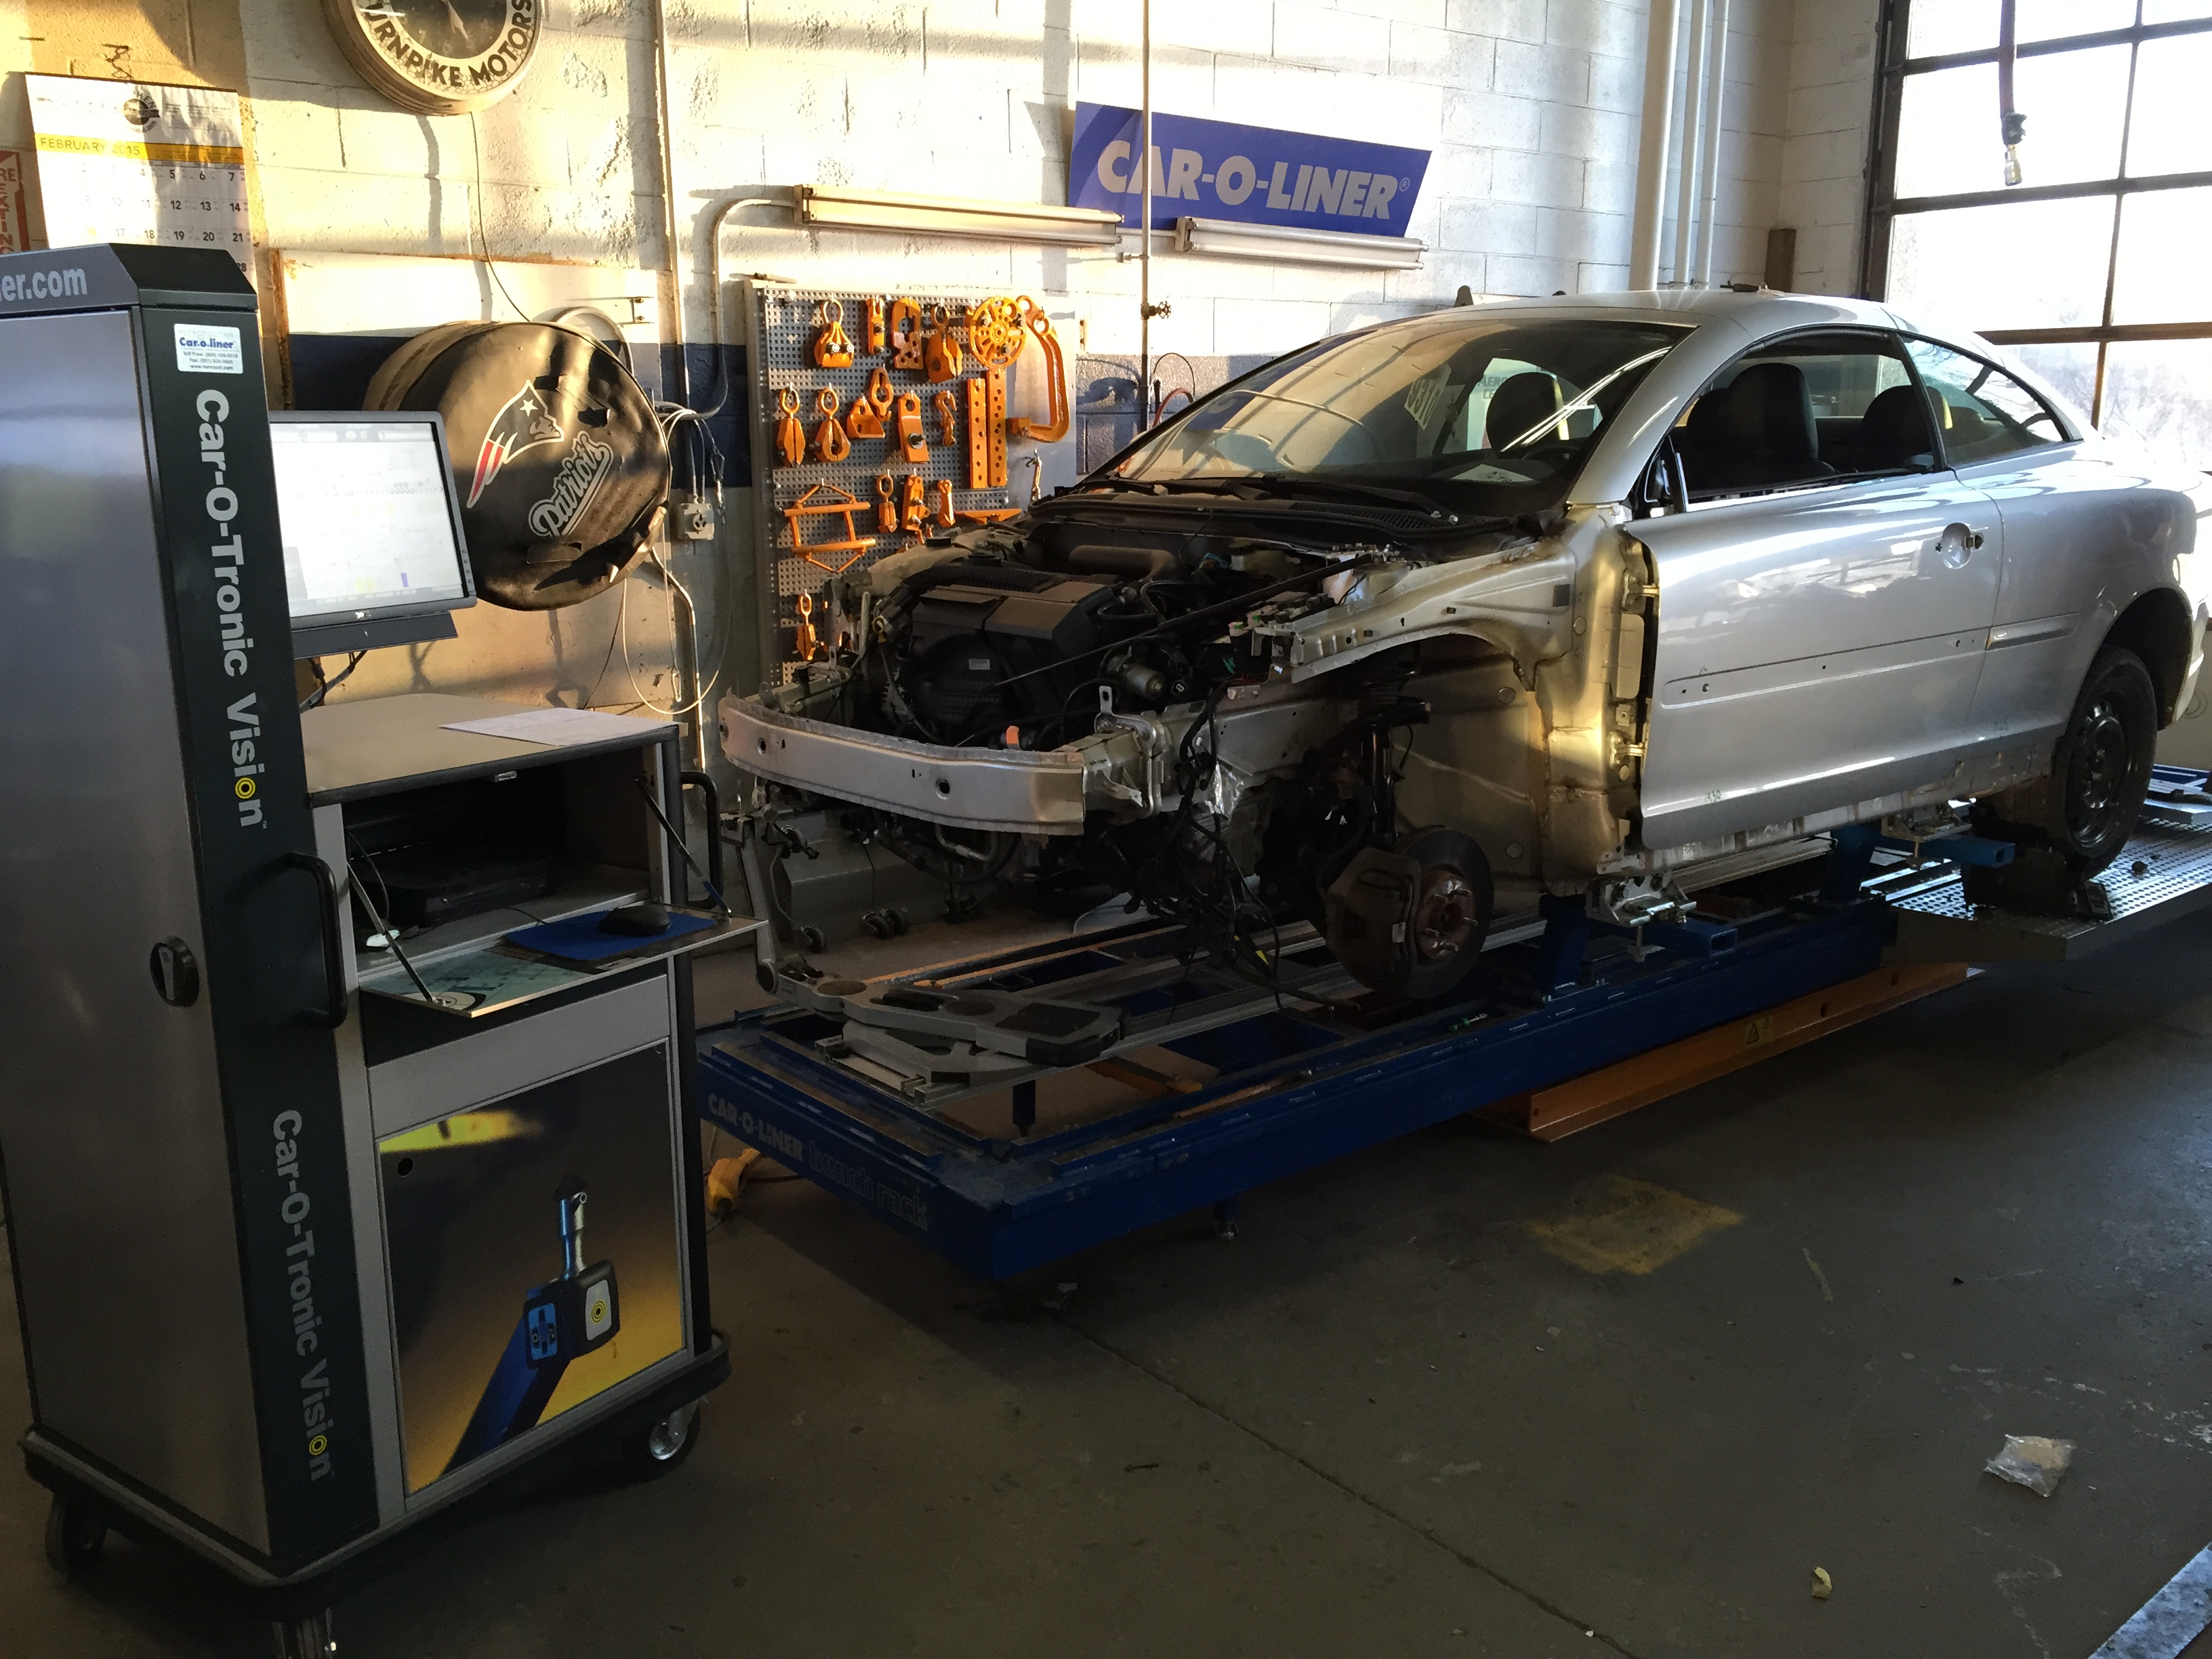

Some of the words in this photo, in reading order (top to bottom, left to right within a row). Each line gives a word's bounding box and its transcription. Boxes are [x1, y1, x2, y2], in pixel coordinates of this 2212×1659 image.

[363, 3, 463, 87] URNPIKE
[468, 0, 532, 86] MOTORS
[40, 138, 106, 152] FEBRUARY
[112, 144, 140, 156] 2015
[140, 168, 146, 177] 4
[169, 169, 176, 179] 5
[199, 170, 205, 180] 6
[228, 172, 234, 182] 7
[1097, 140, 1398, 220] CAR-O-LINER
[112, 197, 122, 207] 10
[141, 199, 150, 208] 11
[170, 200, 182, 210] 12
[200, 201, 211, 211] 13
[229, 203, 241, 212] 14
[115, 228, 125, 237] 17
[144, 229, 155, 239] 18
[173, 230, 185, 241] 19
[203, 232, 215, 242] 20
[232, 232, 243, 243] 21
[0, 268, 88, 302] er.com
[178, 330, 234, 338] METROPOLITAN
[528, 430, 613, 537] Patriots
[197, 390, 254, 677] Car-O-Tronic
[226, 692, 266, 827] Vision
[708, 1092, 804, 1163] CAR-O-LINER
[273, 1109, 323, 1357] Car-O-Tronic
[300, 1358, 333, 1481] Vision
